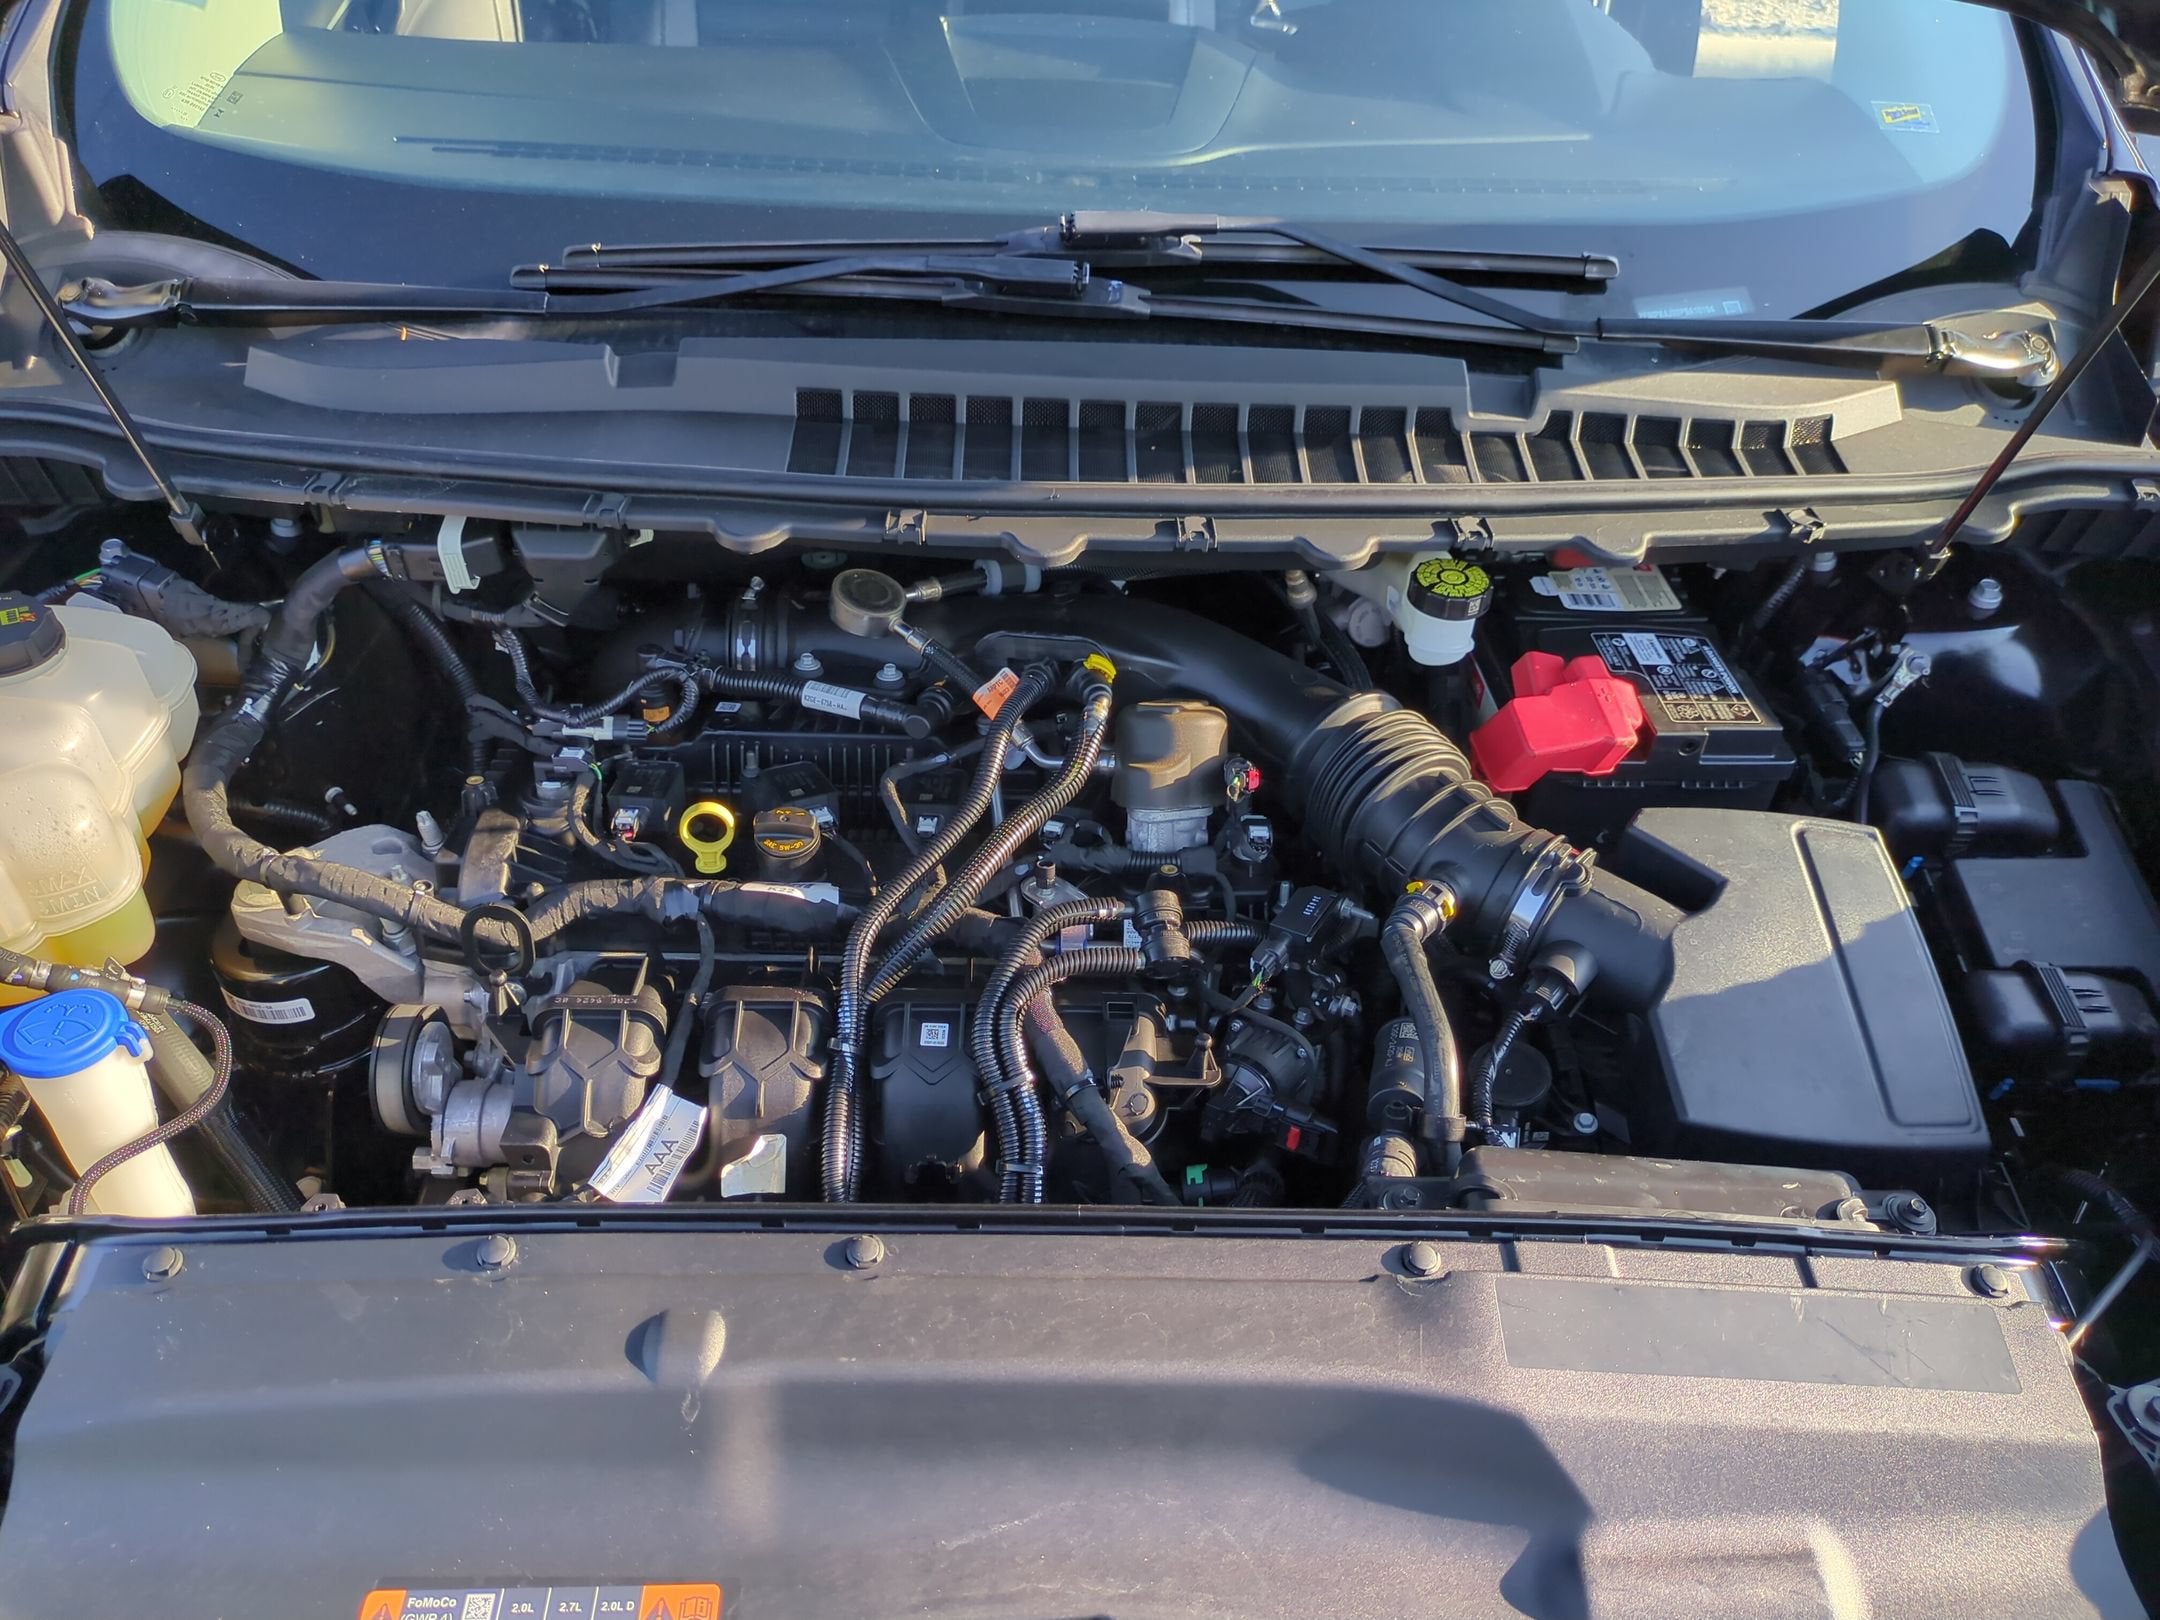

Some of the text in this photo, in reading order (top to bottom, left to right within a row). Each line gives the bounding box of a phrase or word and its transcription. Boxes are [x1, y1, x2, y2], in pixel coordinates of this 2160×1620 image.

[41, 867, 92, 894] MAX
[49, 886, 101, 914] MIN
[644, 1138, 680, 1176] AAA
[407, 1596, 457, 1608] FoMoCo
[511, 1602, 535, 1614] 2.0L
[558, 1601, 582, 1613] 2.7L
[600, 1600, 635, 1612] 2.0L D
